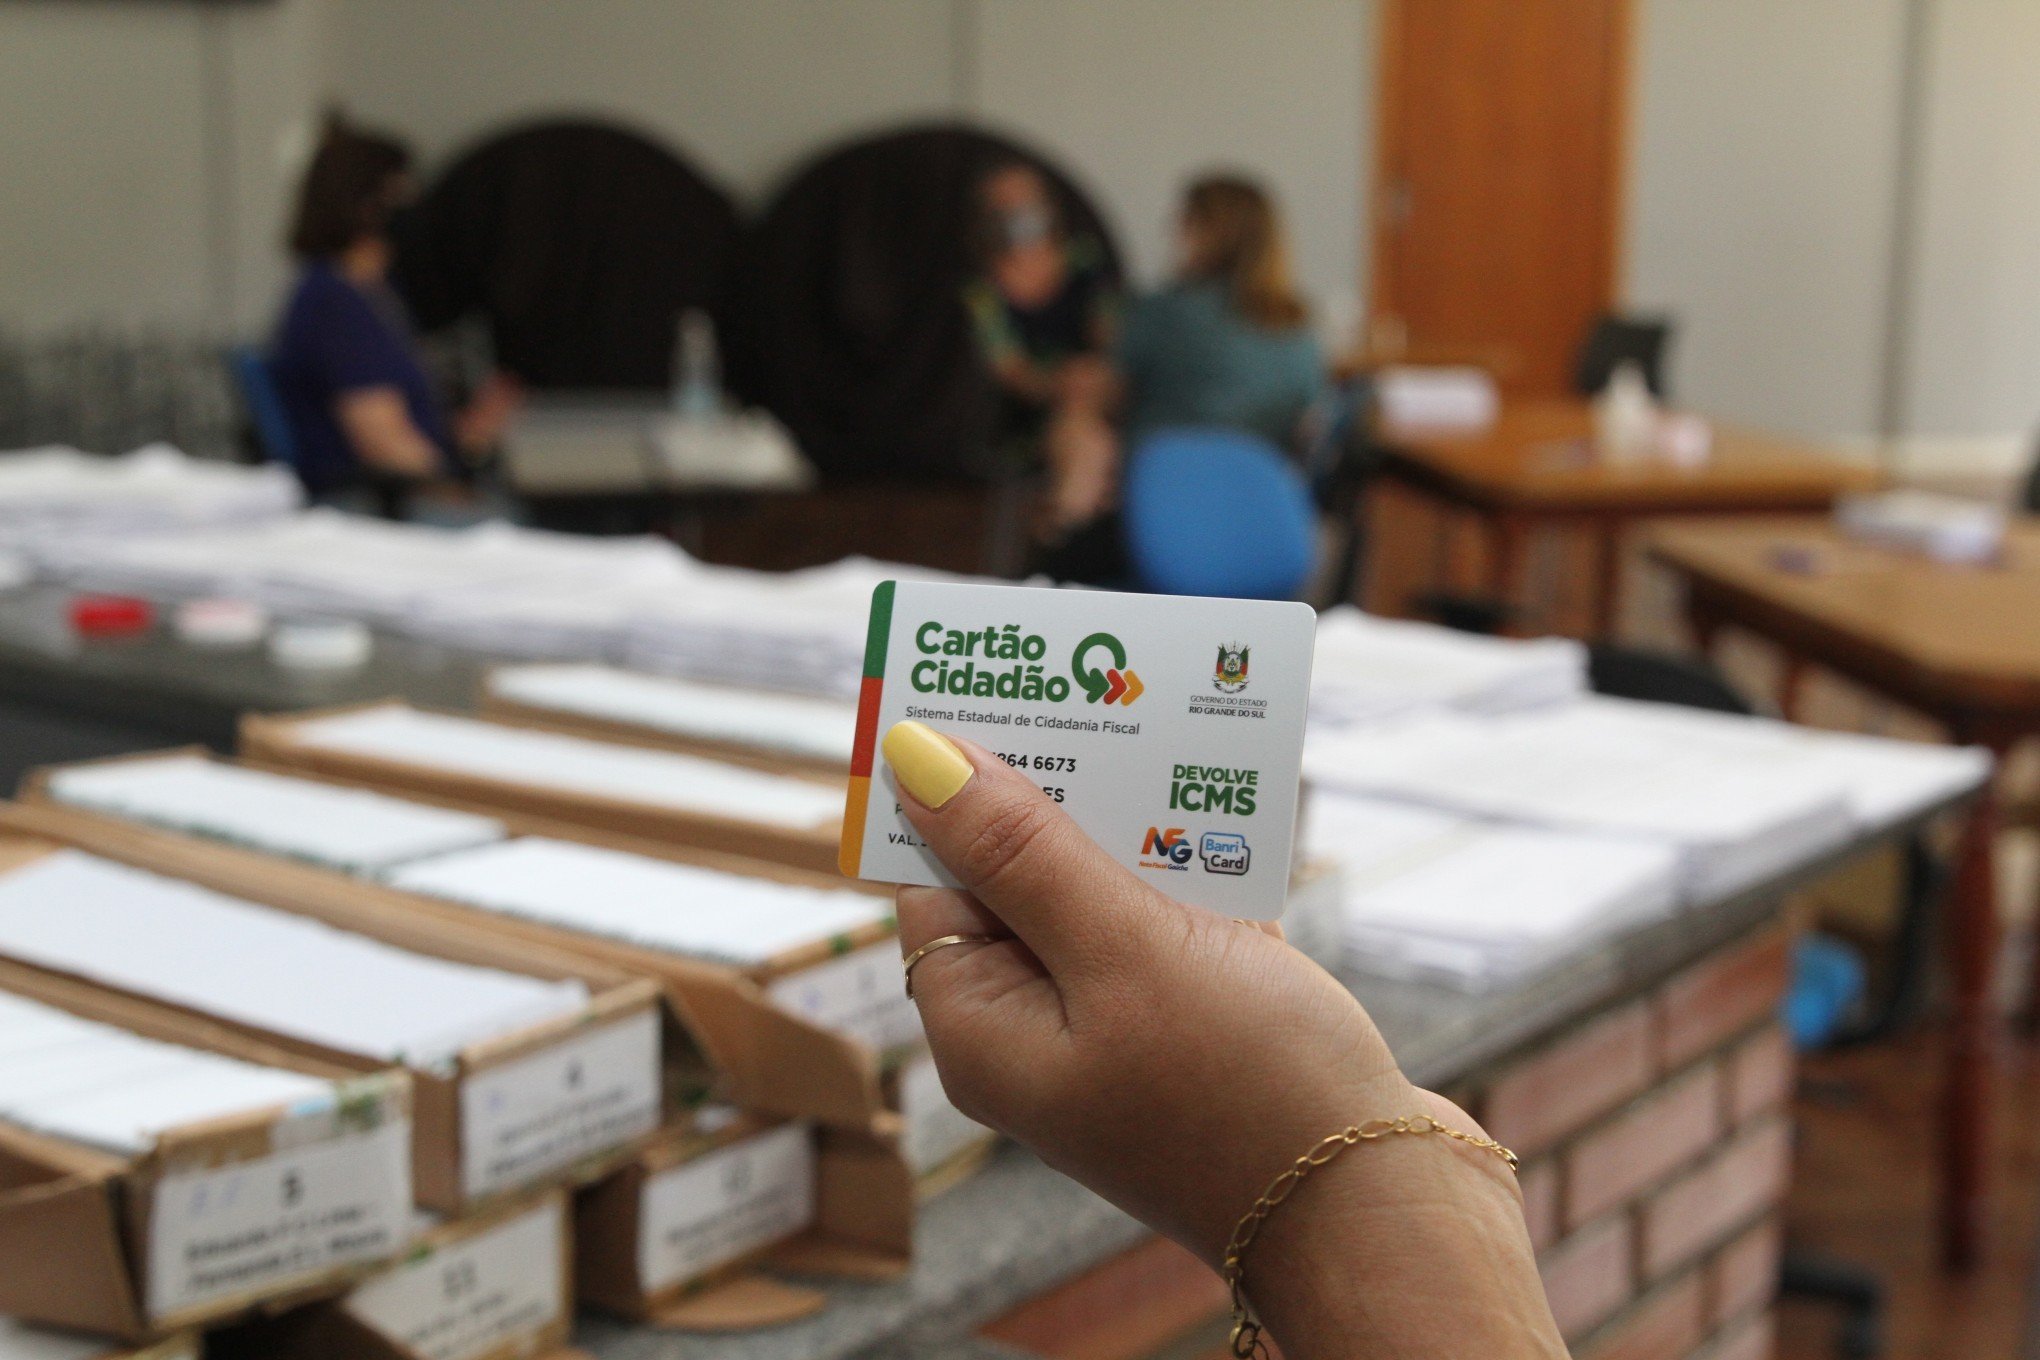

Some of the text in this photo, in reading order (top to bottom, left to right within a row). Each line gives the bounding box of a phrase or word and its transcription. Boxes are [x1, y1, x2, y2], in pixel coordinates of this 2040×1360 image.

[915, 621, 1047, 661] Cartão
[910, 660, 1070, 703] Cidadão
[1190, 695, 1268, 707] GOVERNO DO ESTADO
[905, 706, 1140, 735] Sistema Estadual de Cidadania Fiscal
[1189, 706, 1266, 719] RIO GRANDE DO SUL
[1033, 756, 1077, 773] 6673
[1172, 764, 1259, 786] DEVOLVE
[1169, 781, 1257, 816] ICMS
[1141, 826, 1193, 865] NFG
[1205, 838, 1239, 854] Banri
[1210, 854, 1244, 870] Card
